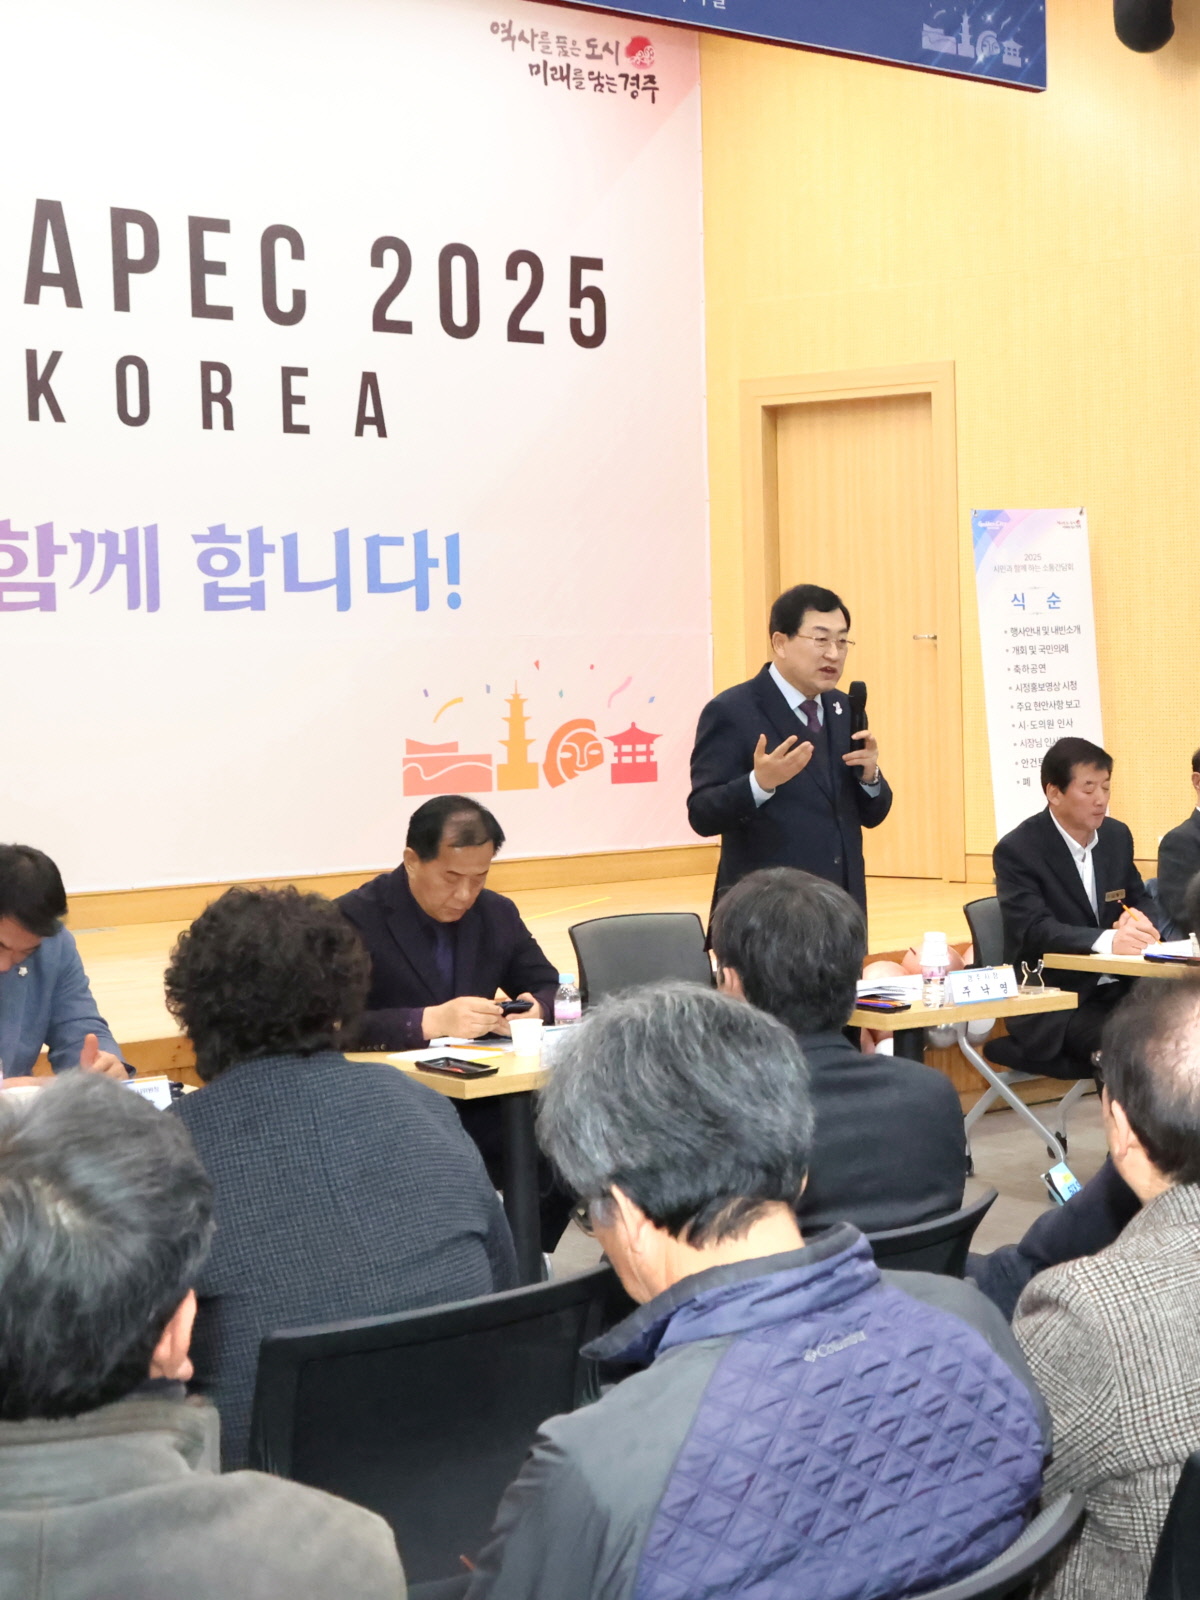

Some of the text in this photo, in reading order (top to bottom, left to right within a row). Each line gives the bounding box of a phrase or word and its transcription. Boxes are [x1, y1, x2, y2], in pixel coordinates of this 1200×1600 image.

[490, 19, 620, 66] 역사를 품은 도시
[528, 60, 660, 104] 미래를 담는 경주
[23, 198, 608, 350] APEC 2025
[25, 348, 388, 439] KOREA
[1024, 553, 1042, 562] 2025
[0, 518, 463, 614] 함께 합니다!
[1010, 624, 1081, 638] 행사안내 및 내빈소개
[1012, 644, 1069, 656] 개회 및 국민의례
[1013, 664, 1047, 675] 축하공연
[1015, 682, 1061, 693] 시정홍보영상
[1016, 700, 1081, 712] 주요 현안사항 보고
[1057, 718, 1073, 728] 인사
[1020, 738, 1043, 749] 시장님
